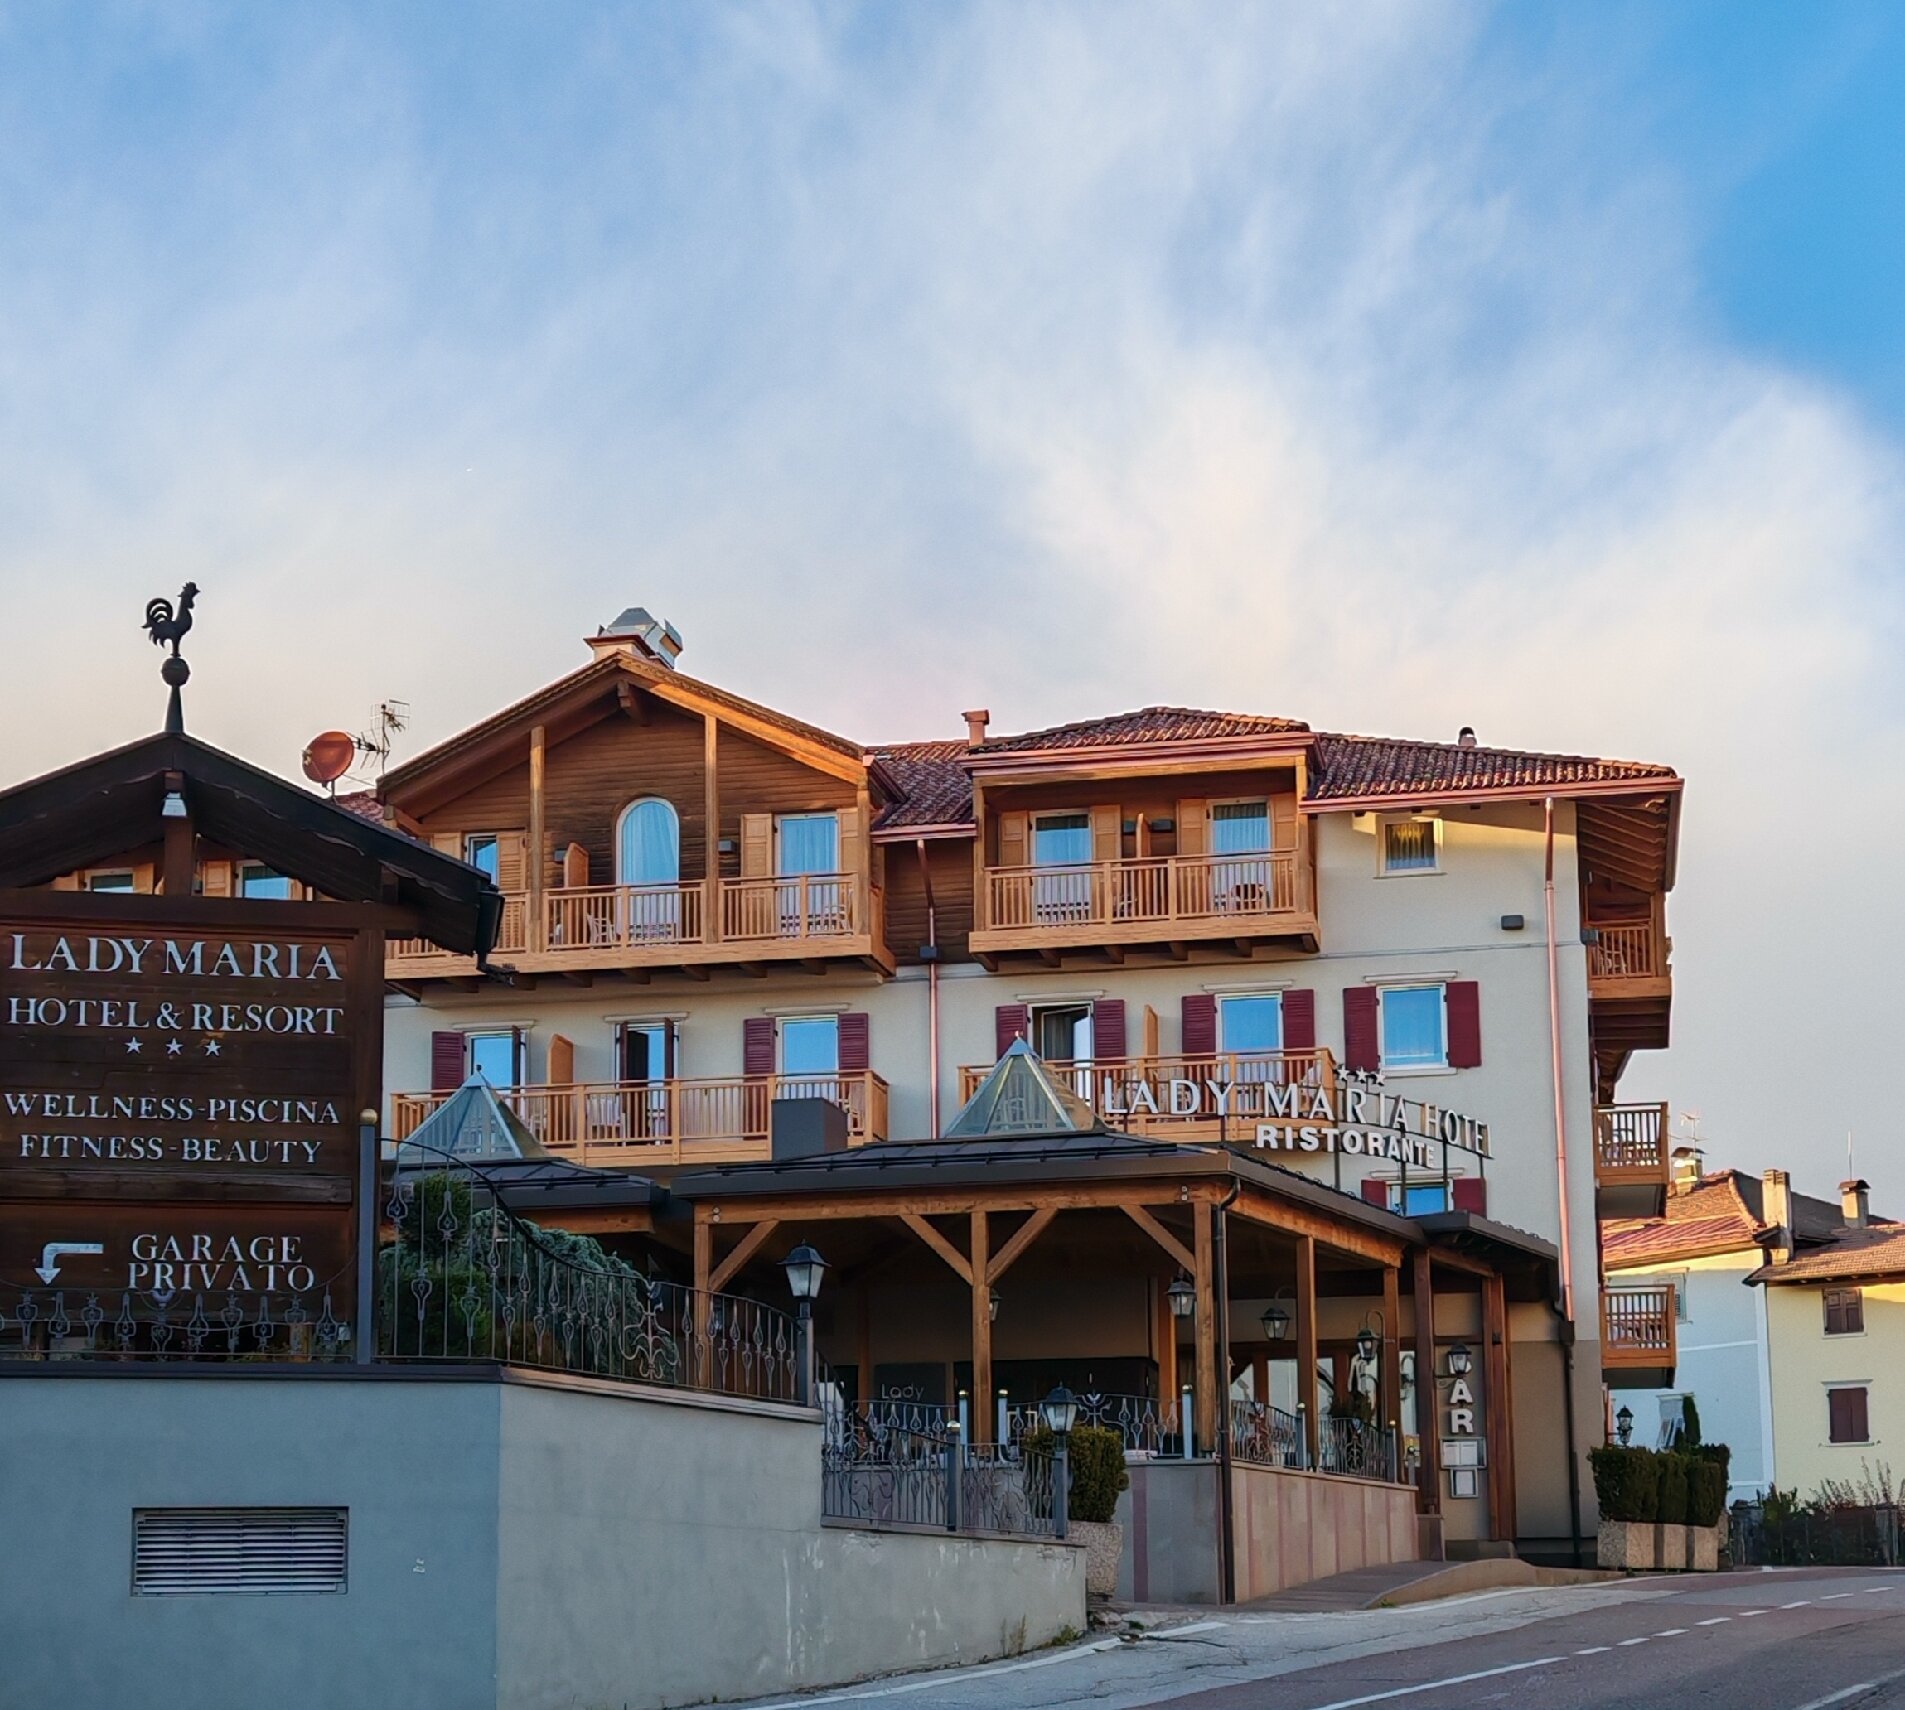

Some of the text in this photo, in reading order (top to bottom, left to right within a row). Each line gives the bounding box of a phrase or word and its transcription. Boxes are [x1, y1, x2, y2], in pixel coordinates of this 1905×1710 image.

[9, 933, 343, 981] LADY MARIA
[6, 996, 344, 1035] HOTEL & RESORT
[1104, 1076, 1235, 1116] LADY
[1263, 1081, 1409, 1133] MARIA
[1255, 1123, 1435, 1168] RISTORANTE
[131, 1233, 304, 1264] GARAGE
[127, 1262, 315, 1293] PRIVATO
[881, 1382, 925, 1401] Lady
